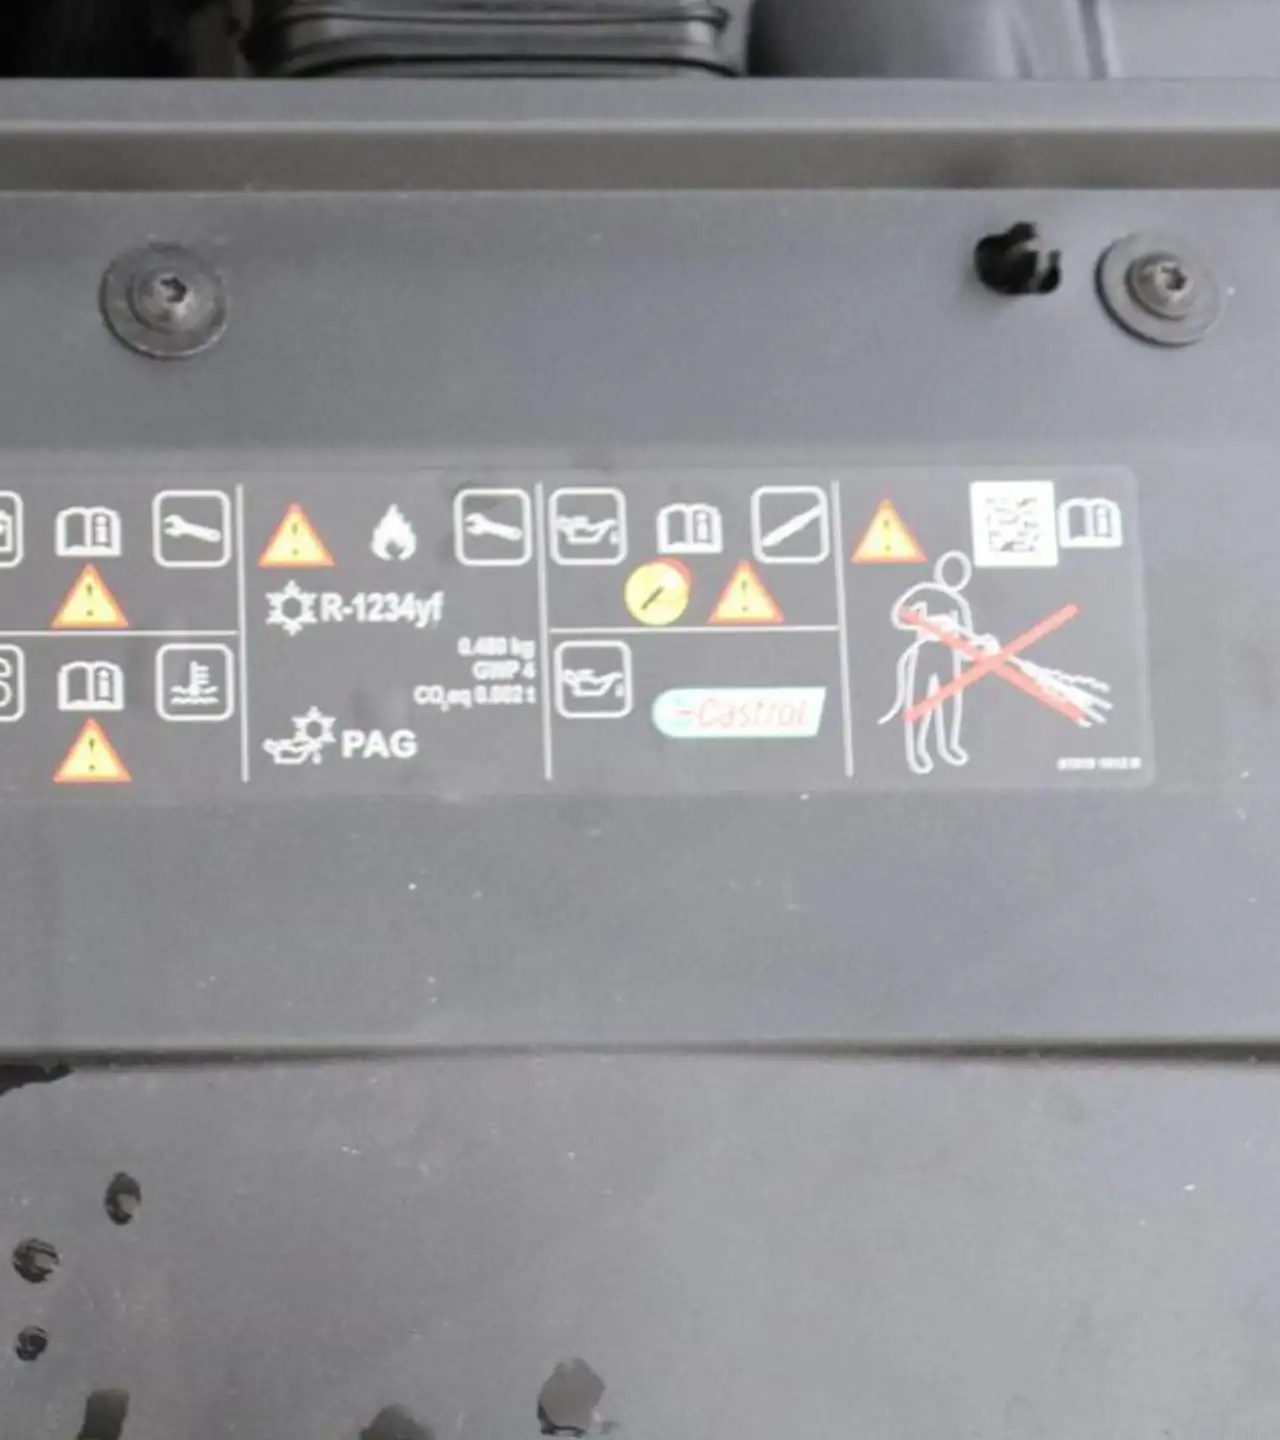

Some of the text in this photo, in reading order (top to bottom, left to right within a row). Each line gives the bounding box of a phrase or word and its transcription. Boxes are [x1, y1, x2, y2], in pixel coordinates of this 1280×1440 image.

[320, 591, 446, 629] R-1234yf
[698, 696, 810, 729] Castrol
[341, 728, 419, 759] PAG
